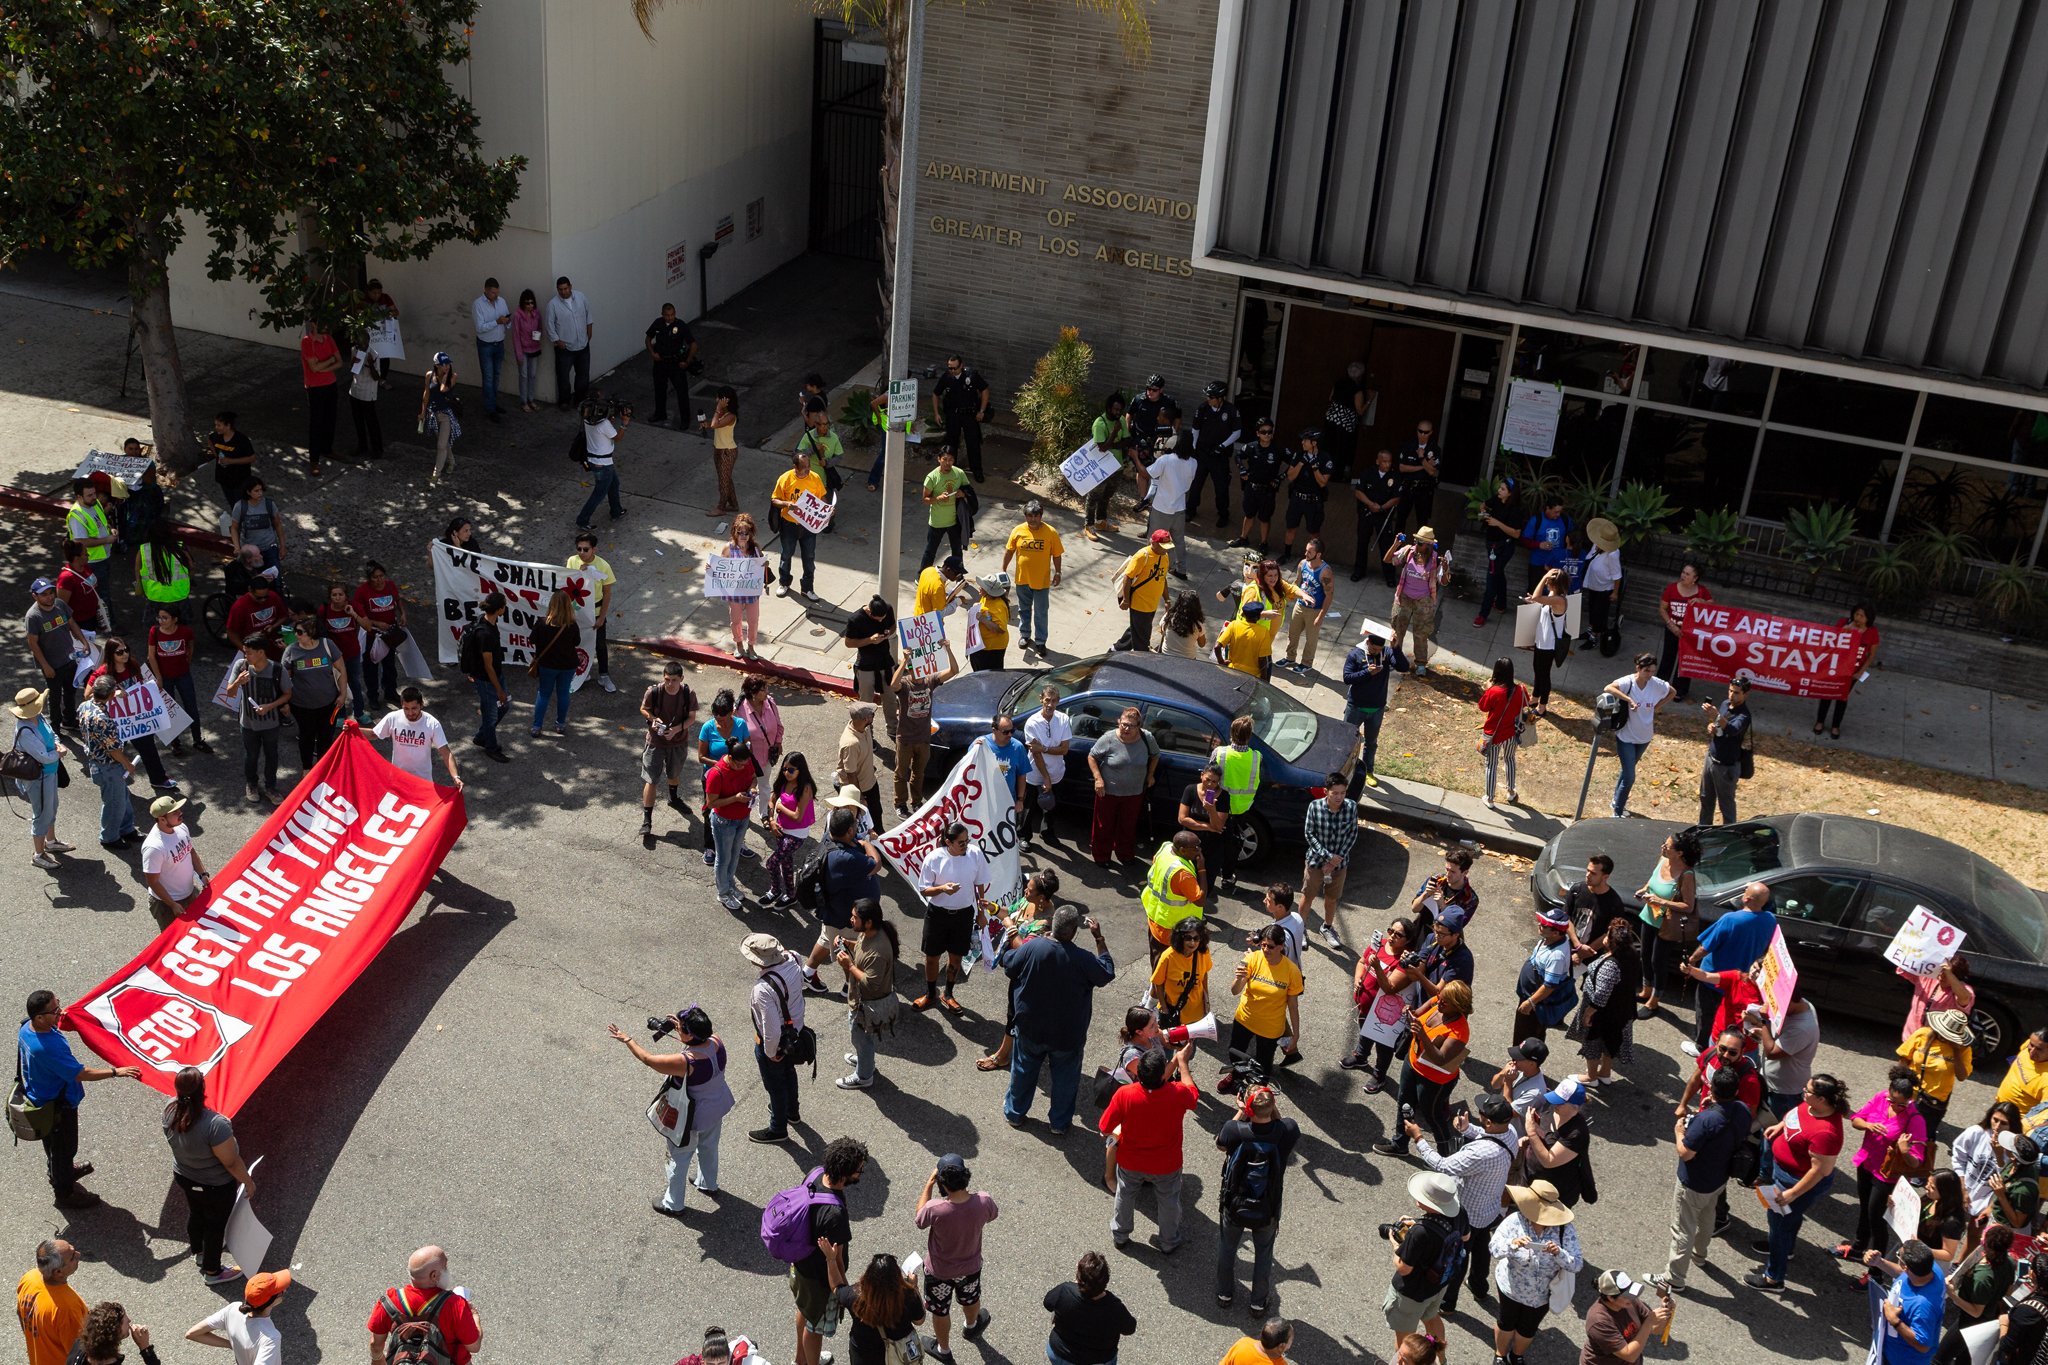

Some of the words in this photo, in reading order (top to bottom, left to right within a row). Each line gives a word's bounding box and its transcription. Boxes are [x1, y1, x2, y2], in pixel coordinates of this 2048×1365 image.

[925, 160, 1050, 197] APARTMENT
[1047, 208, 1077, 229] OF
[929, 215, 1023, 248] GREATER
[1039, 235, 1080, 258] LOS
[901, 383, 916, 392] HOUR
[891, 393, 916, 404] PARKING
[1063, 447, 1090, 479] STOP
[1091, 468, 1109, 483] LA
[793, 507, 823, 530] DAMN
[446, 548, 482, 574] WE
[494, 563, 562, 592] SHALL
[712, 571, 735, 579] ELLIS
[479, 577, 540, 610] NOT
[444, 598, 479, 621] BE
[906, 621, 937, 641] NOISE
[912, 615, 927, 628] NO
[1693, 607, 1731, 629] WE
[1734, 615, 1784, 641] ARE
[1788, 625, 1852, 650] HERE
[509, 632, 536, 649] HER
[910, 640, 943, 660] FAMILIES
[919, 634, 932, 647] NO
[923, 653, 936, 665] NO
[1692, 628, 1737, 658] TO
[1745, 642, 1840, 677] STAY!
[915, 660, 938, 678] FUN
[108, 685, 154, 719] ALTO
[394, 735, 426, 746] RENTER
[400, 728, 416, 739] AM
[418, 731, 426, 740] A
[880, 764, 983, 859] QUEREMOS
[175, 839, 187, 854] AM
[161, 781, 360, 988] GENTRIFYING
[230, 932, 322, 998] LOS
[289, 792, 432, 938] ANGELES
[127, 999, 202, 1061] STOP
